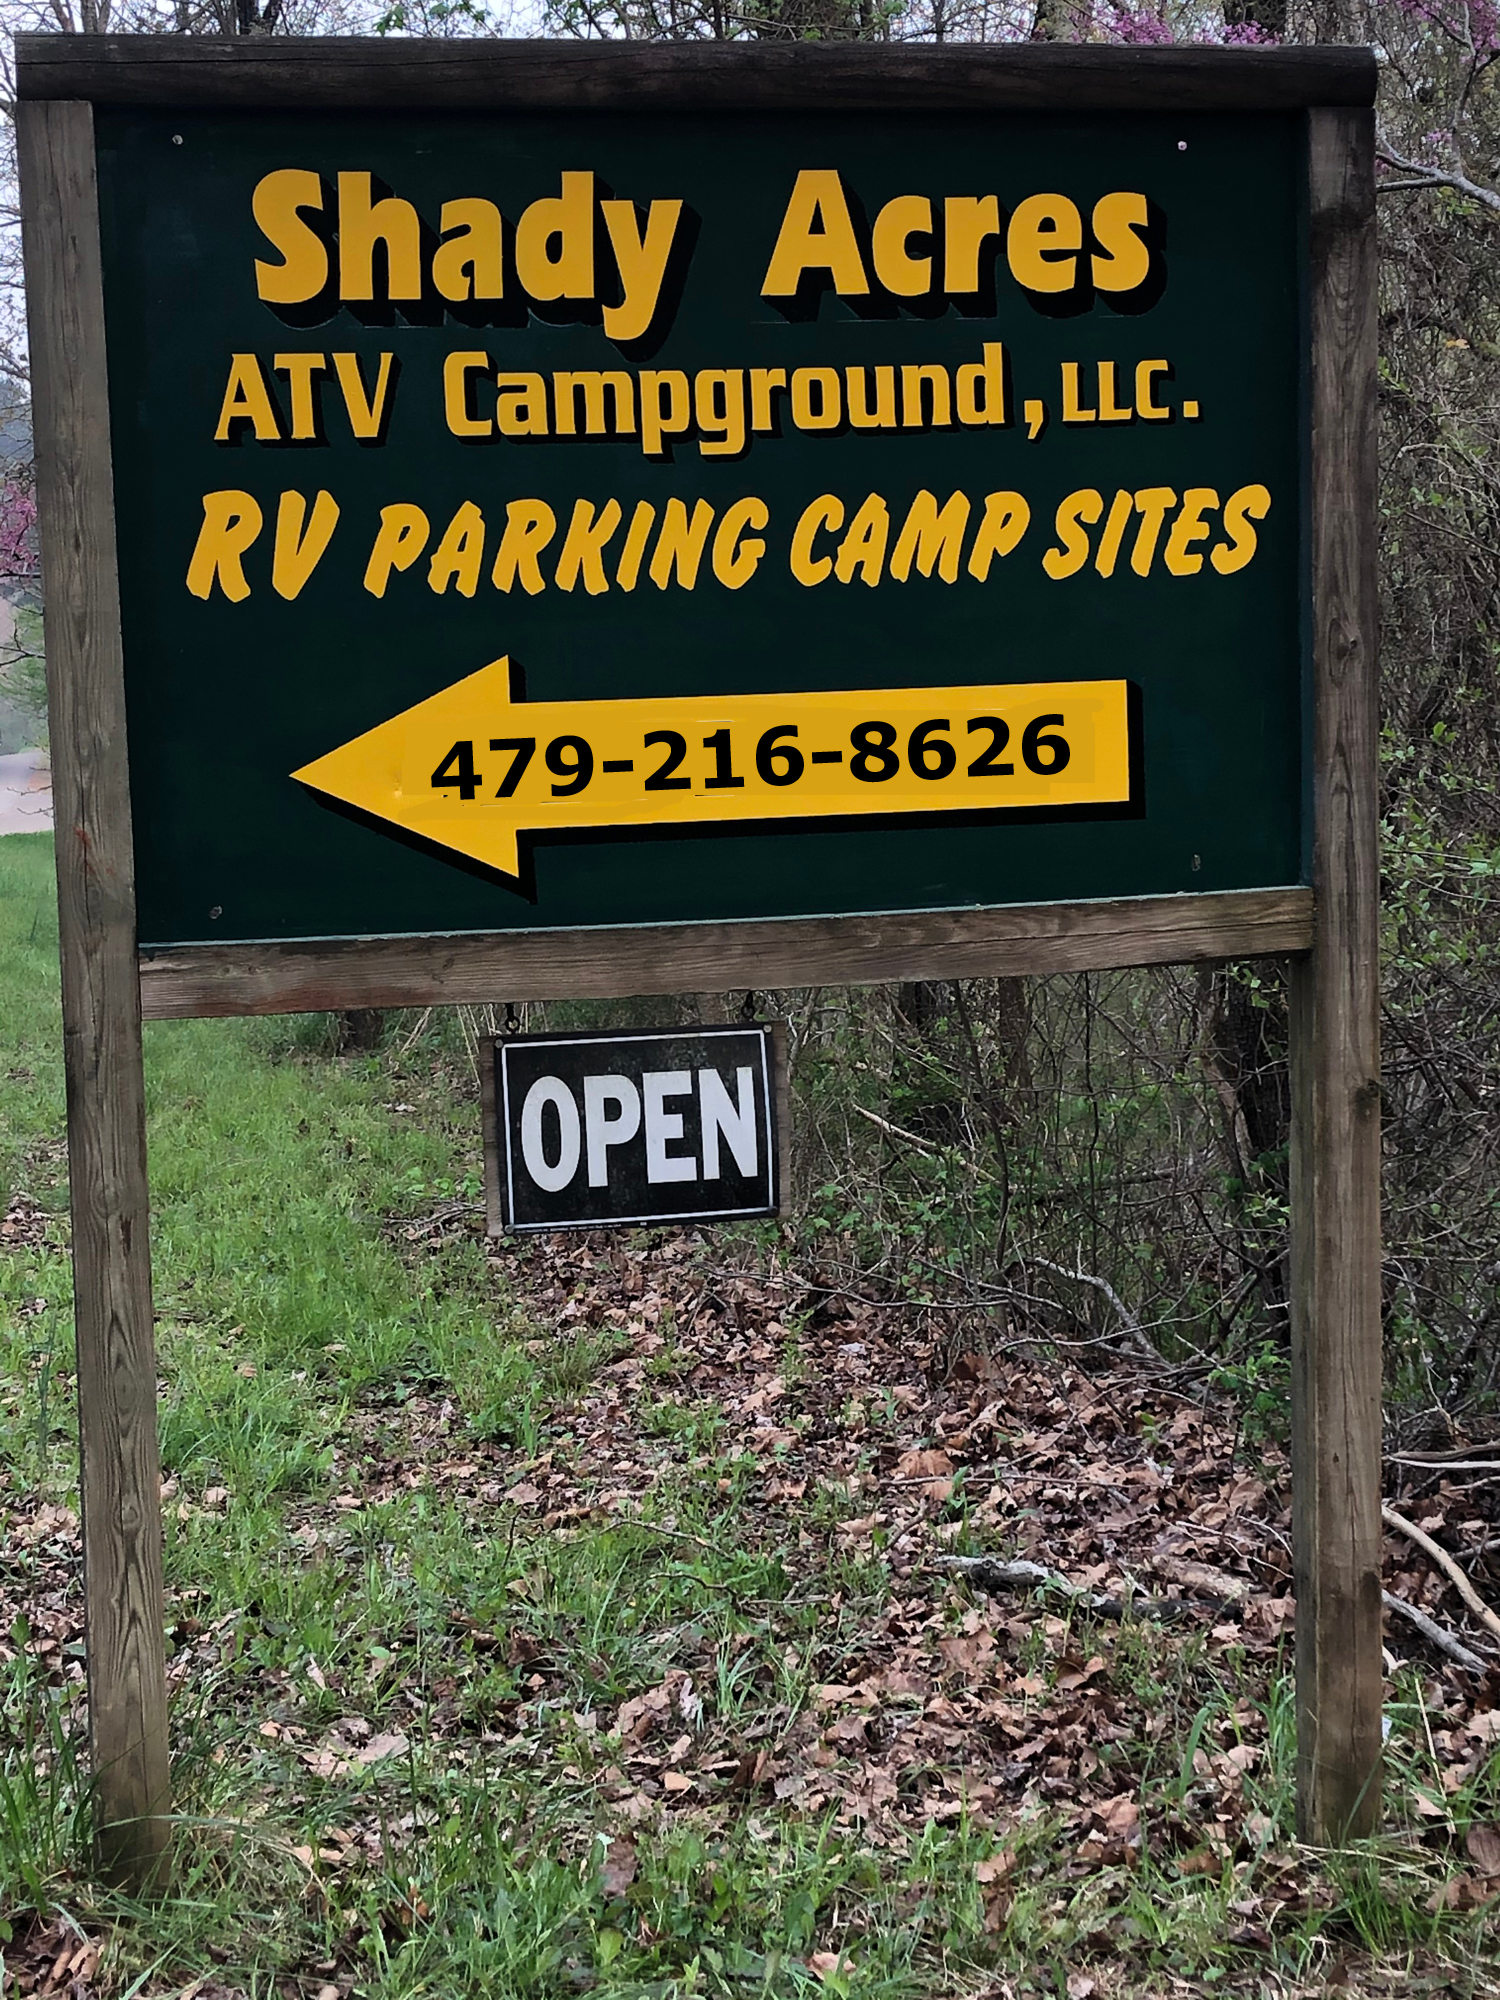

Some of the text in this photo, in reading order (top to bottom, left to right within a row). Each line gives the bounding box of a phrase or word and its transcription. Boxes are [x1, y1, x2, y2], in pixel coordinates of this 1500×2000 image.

[252, 169, 1150, 340] Shady Acres
[214, 352, 393, 440] ATV
[1061, 359, 1199, 421] LLC.
[186, 484, 1272, 603] RV PARKING CAMP SITES
[430, 713, 1071, 801] 479-216-8626
[520, 1066, 759, 1192] OPEN
